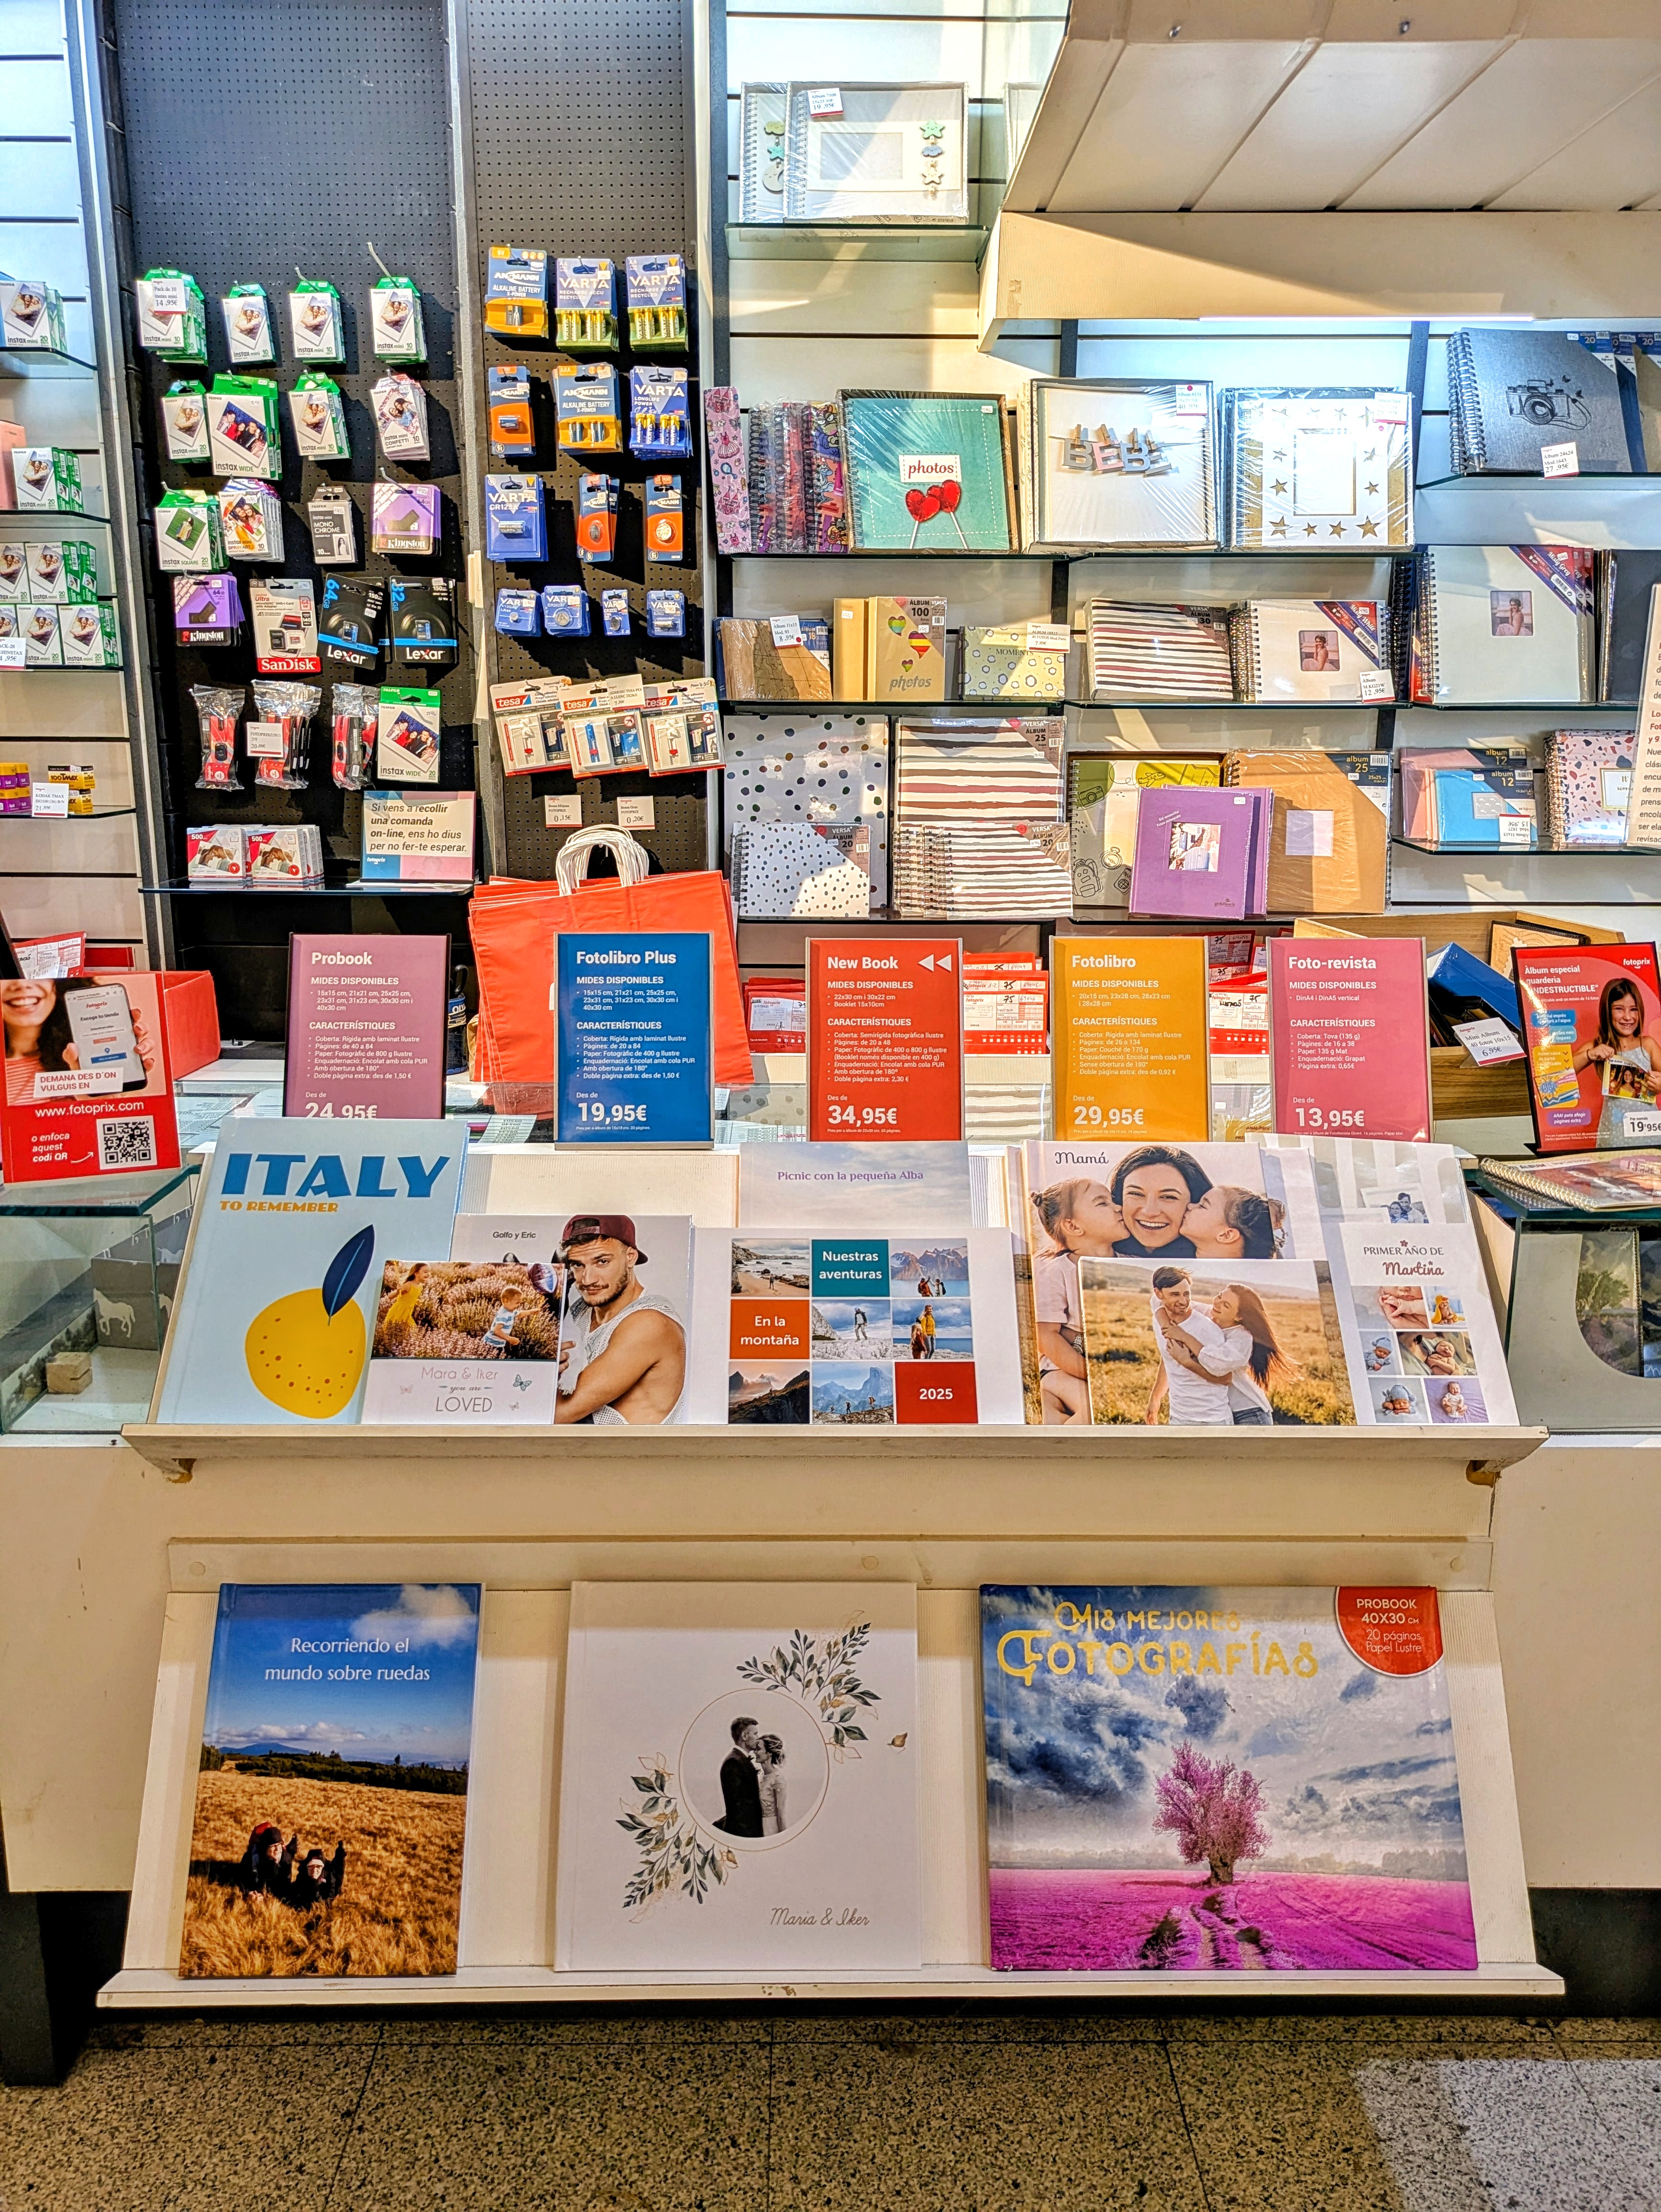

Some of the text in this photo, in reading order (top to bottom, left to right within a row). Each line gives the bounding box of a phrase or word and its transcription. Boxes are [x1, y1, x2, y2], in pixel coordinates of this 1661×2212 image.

[494, 273, 539, 281] ANSMANN
[559, 276, 609, 288] VARTA
[634, 385, 685, 396] VARTA
[385, 438, 409, 446] CONFETTI
[215, 461, 237, 472] instax
[908, 460, 954, 479] photos
[388, 539, 425, 549] Kingston
[912, 608, 929, 616] 100
[328, 645, 367, 664] Lexar
[406, 648, 445, 660] Lexar
[261, 660, 316, 671] SanDisk
[889, 675, 931, 691] photos
[498, 698, 521, 707] tesa
[565, 700, 587, 709] tesa
[380, 766, 404, 775] instax
[1355, 763, 1368, 773] 25
[1502, 778, 1514, 786] 12
[371, 803, 380, 812] Si
[383, 805, 405, 813] vens
[415, 804, 448, 813] recollir
[390, 817, 433, 825] comanda
[370, 830, 406, 840] on-line,
[427, 830, 439, 838] ho
[442, 830, 461, 839] dius
[370, 843, 384, 852] per
[402, 842, 427, 852] fer-te
[431, 844, 467, 853] esperar.
[311, 952, 372, 964] Probook
[576, 951, 676, 964] Fotolibro Plus
[828, 956, 898, 969] New Book
[1072, 955, 1136, 967] Fotolibro
[1289, 956, 1376, 969] Foto-revista
[1525, 966, 1548, 974] Àlbum
[1532, 984, 1598, 995] NDESTRUCTIBLE®
[310, 1021, 395, 1029] CARACTERÍSTIQUES
[577, 1021, 662, 1029] CARACTERÍSTIQUES
[1291, 1018, 1375, 1027] CARACTERÍSTIQUES
[1482, 1046, 1502, 1056] 6,95€
[41, 1074, 76, 1083] DEMANA
[41, 1083, 77, 1092] VULGUIS
[35, 1101, 144, 1117] www.fotoprix.com
[306, 1103, 377, 1118] 2495€
[578, 1103, 647, 1124] 19,95€
[828, 1106, 897, 1127] 34,95€
[1074, 1106, 1144, 1127] 29,95€
[1296, 1108, 1364, 1129] 13,95€
[40, 1132, 69, 1141] enfoca
[33, 1143, 62, 1152] aquest
[33, 1154, 53, 1162] codi
[1054, 1151, 1109, 1165] Mamá
[221, 1153, 450, 1198] ITALY
[778, 1172, 810, 1181] Picnic
[837, 1172, 846, 1180] la
[850, 1172, 897, 1183] pequeña
[899, 1172, 923, 1180] Alba
[220, 1201, 338, 1212] TO REMEMBER
[823, 1251, 878, 1261] Nuestras
[1363, 1245, 1444, 1256] PRIMER AÑO DE
[819, 1270, 882, 1279] aventuras
[1382, 1261, 1444, 1277] Martina
[755, 1316, 785, 1327] En la
[741, 1334, 799, 1346] montaña
[421, 1367, 498, 1380] Mara & Iker
[919, 1388, 953, 1400] 2025
[436, 1397, 492, 1412] LOVED
[1356, 1599, 1417, 1610] PROBOOK
[1127, 1611, 1241, 1632] MEJORES
[1361, 1613, 1405, 1625] 40X30
[1366, 1630, 1421, 1643] 20 páginas
[290, 1637, 409, 1652] Recorriendo el
[1366, 1641, 1422, 1655] Papel Lustre
[997, 1630, 1319, 1687] FOTOGRAFÍAS
[264, 1665, 431, 1680] mundo sobre ruedas
[770, 1908, 870, 1925] Maria & Iker
